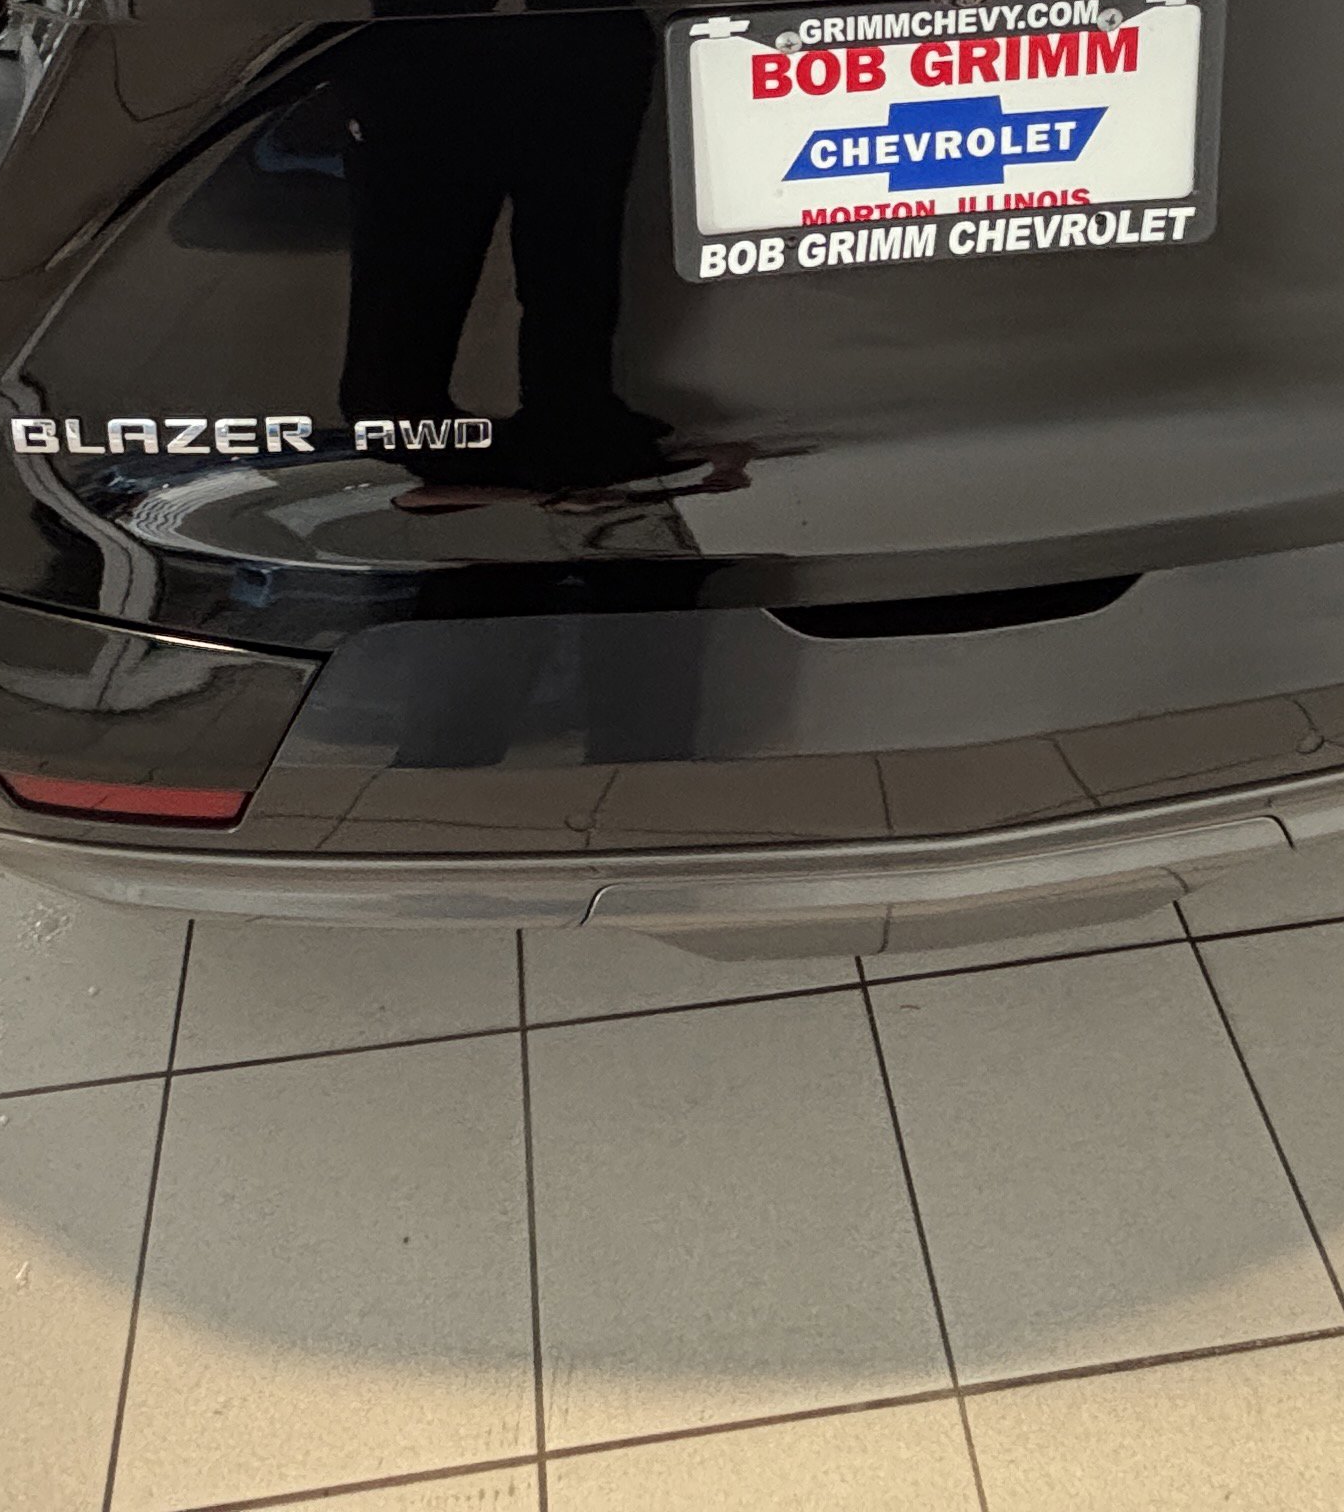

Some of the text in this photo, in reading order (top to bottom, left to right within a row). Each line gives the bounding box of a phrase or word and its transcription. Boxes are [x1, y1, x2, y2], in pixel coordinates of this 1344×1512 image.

[798, 0, 1099, 46] GRIMMCHEVY.COM
[751, 27, 1139, 100] BOB GRIMM
[809, 120, 1077, 170] CHEVROLET
[699, 206, 1196, 280] BOB GRIMM CHEVROLET
[10, 415, 494, 455] BLAZER AWD
